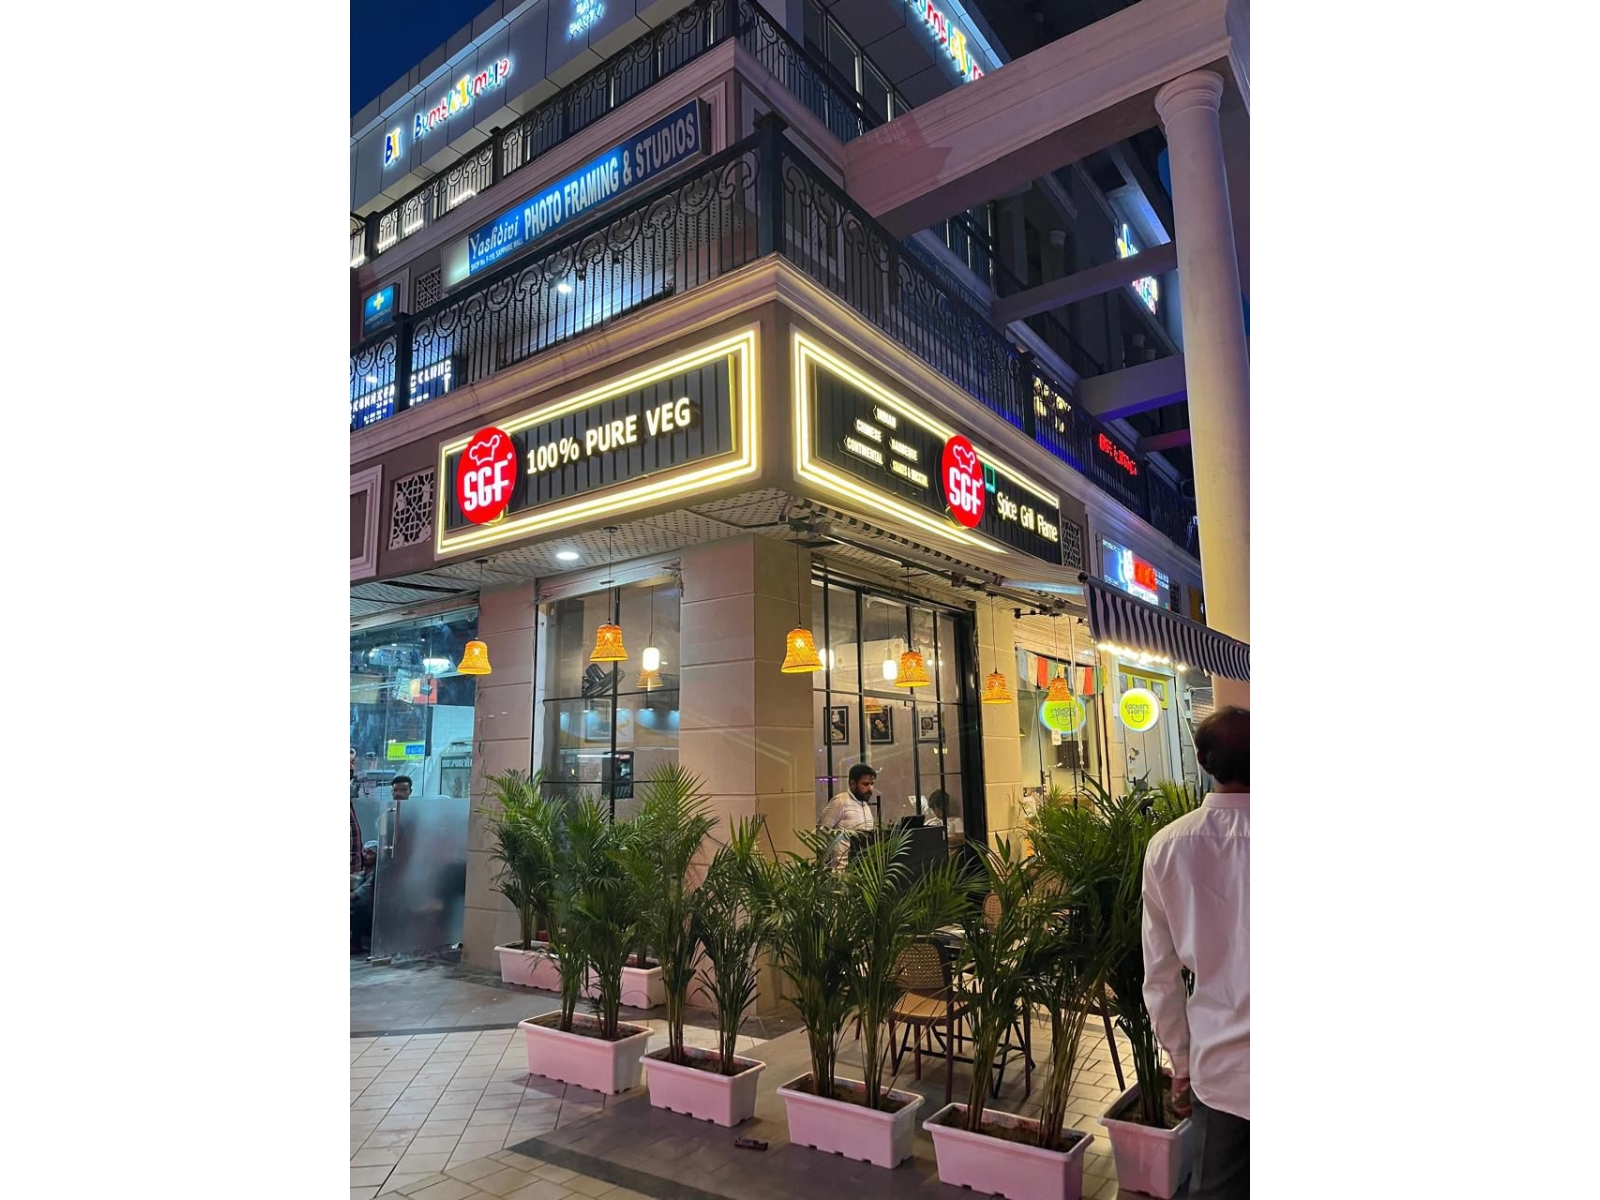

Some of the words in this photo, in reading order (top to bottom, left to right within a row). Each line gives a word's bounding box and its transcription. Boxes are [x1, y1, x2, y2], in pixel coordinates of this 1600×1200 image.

[524, 190, 562, 240] PHOTO
[564, 157, 619, 218] FRAMING
[623, 150, 632, 186] &
[635, 112, 695, 178] STUDIOS
[527, 436, 579, 475] 100%
[586, 414, 637, 456] PURE
[646, 397, 691, 436] VEG
[463, 459, 509, 511] SGF
[949, 467, 982, 515] SGF
[997, 491, 1018, 521] Spice
[1020, 505, 1035, 531] Grill
[1037, 513, 1058, 542] Flame
